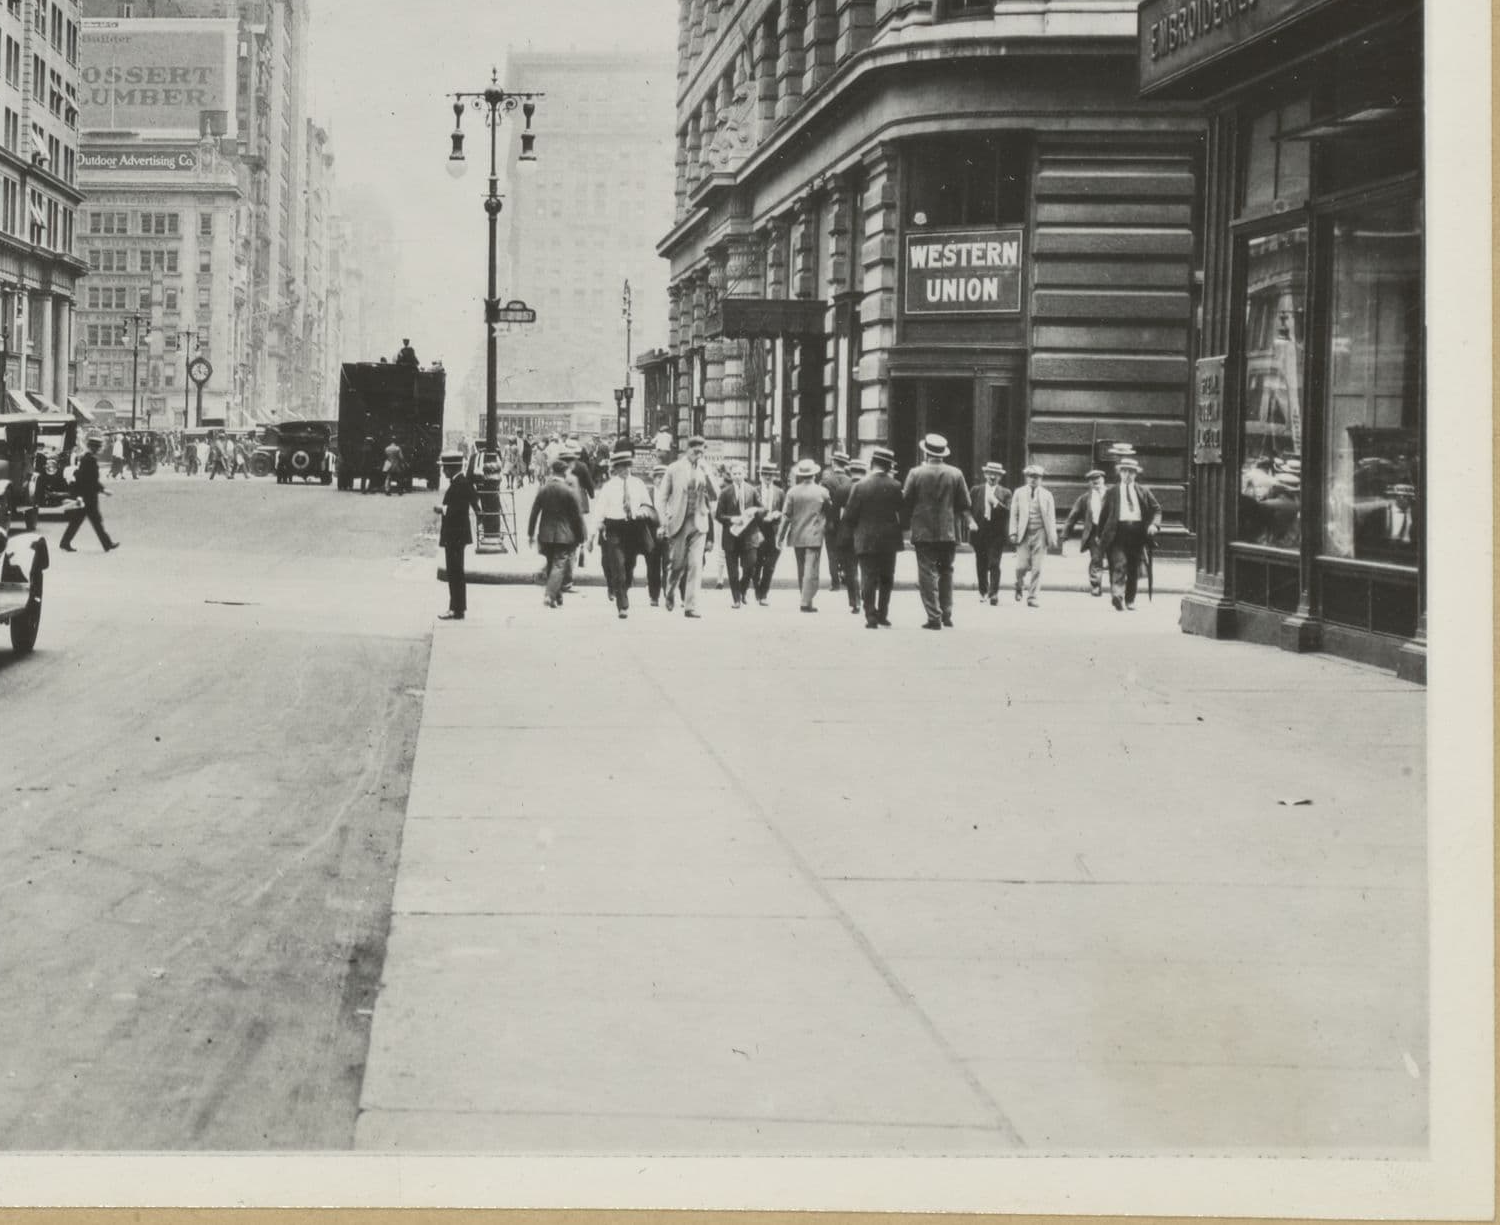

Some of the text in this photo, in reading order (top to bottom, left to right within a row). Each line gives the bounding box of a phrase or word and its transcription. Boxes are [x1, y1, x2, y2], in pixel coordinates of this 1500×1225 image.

[80, 65, 214, 85] OSSERT
[119, 154, 176, 171] Advertising
[910, 240, 1019, 269] WESTERN
[926, 276, 999, 302] UNION
